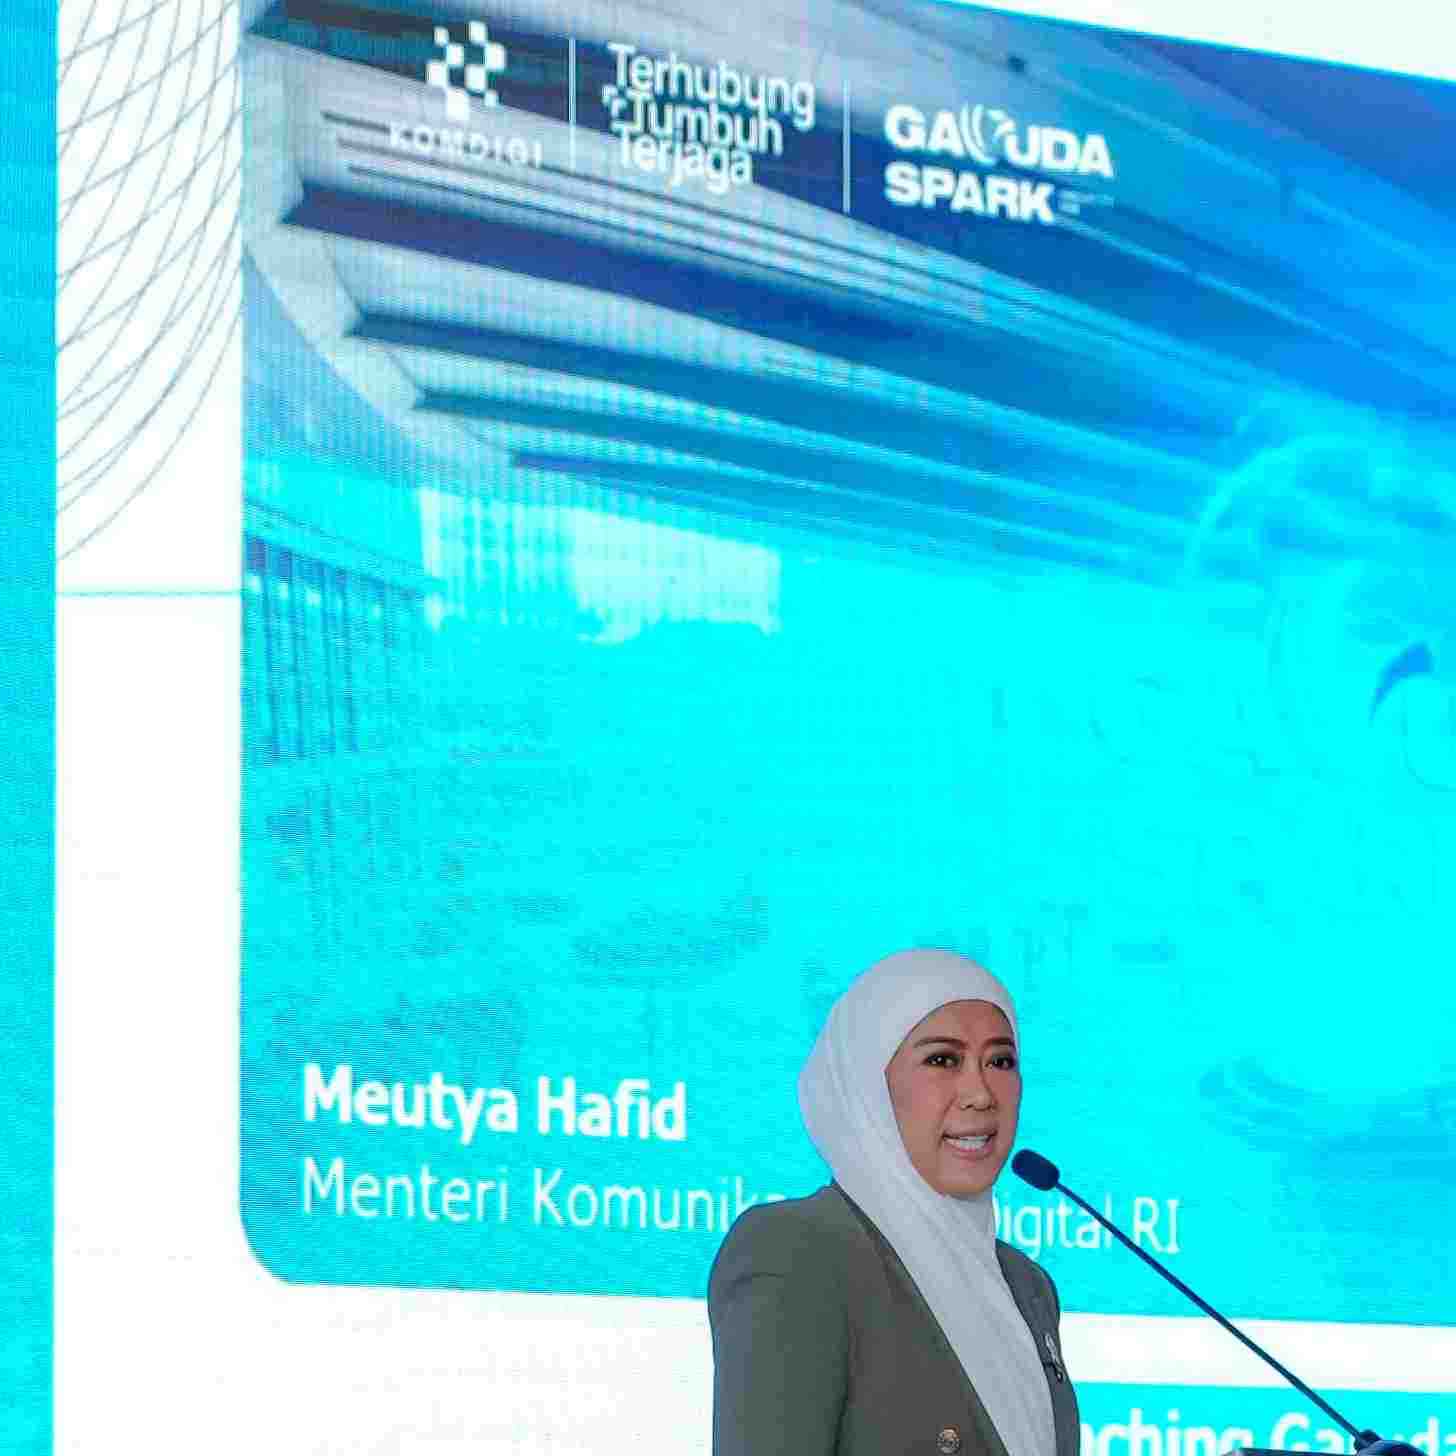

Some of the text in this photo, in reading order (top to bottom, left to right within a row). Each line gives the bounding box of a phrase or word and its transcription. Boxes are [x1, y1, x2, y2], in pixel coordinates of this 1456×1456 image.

[607, 42, 817, 132] Terhubung
[611, 121, 752, 194] Terjaga
[884, 161, 1056, 225] SPARK
[302, 1062, 687, 1146] Meutya Hafid
[302, 1156, 1180, 1261] Menteri Komunik igital RI
